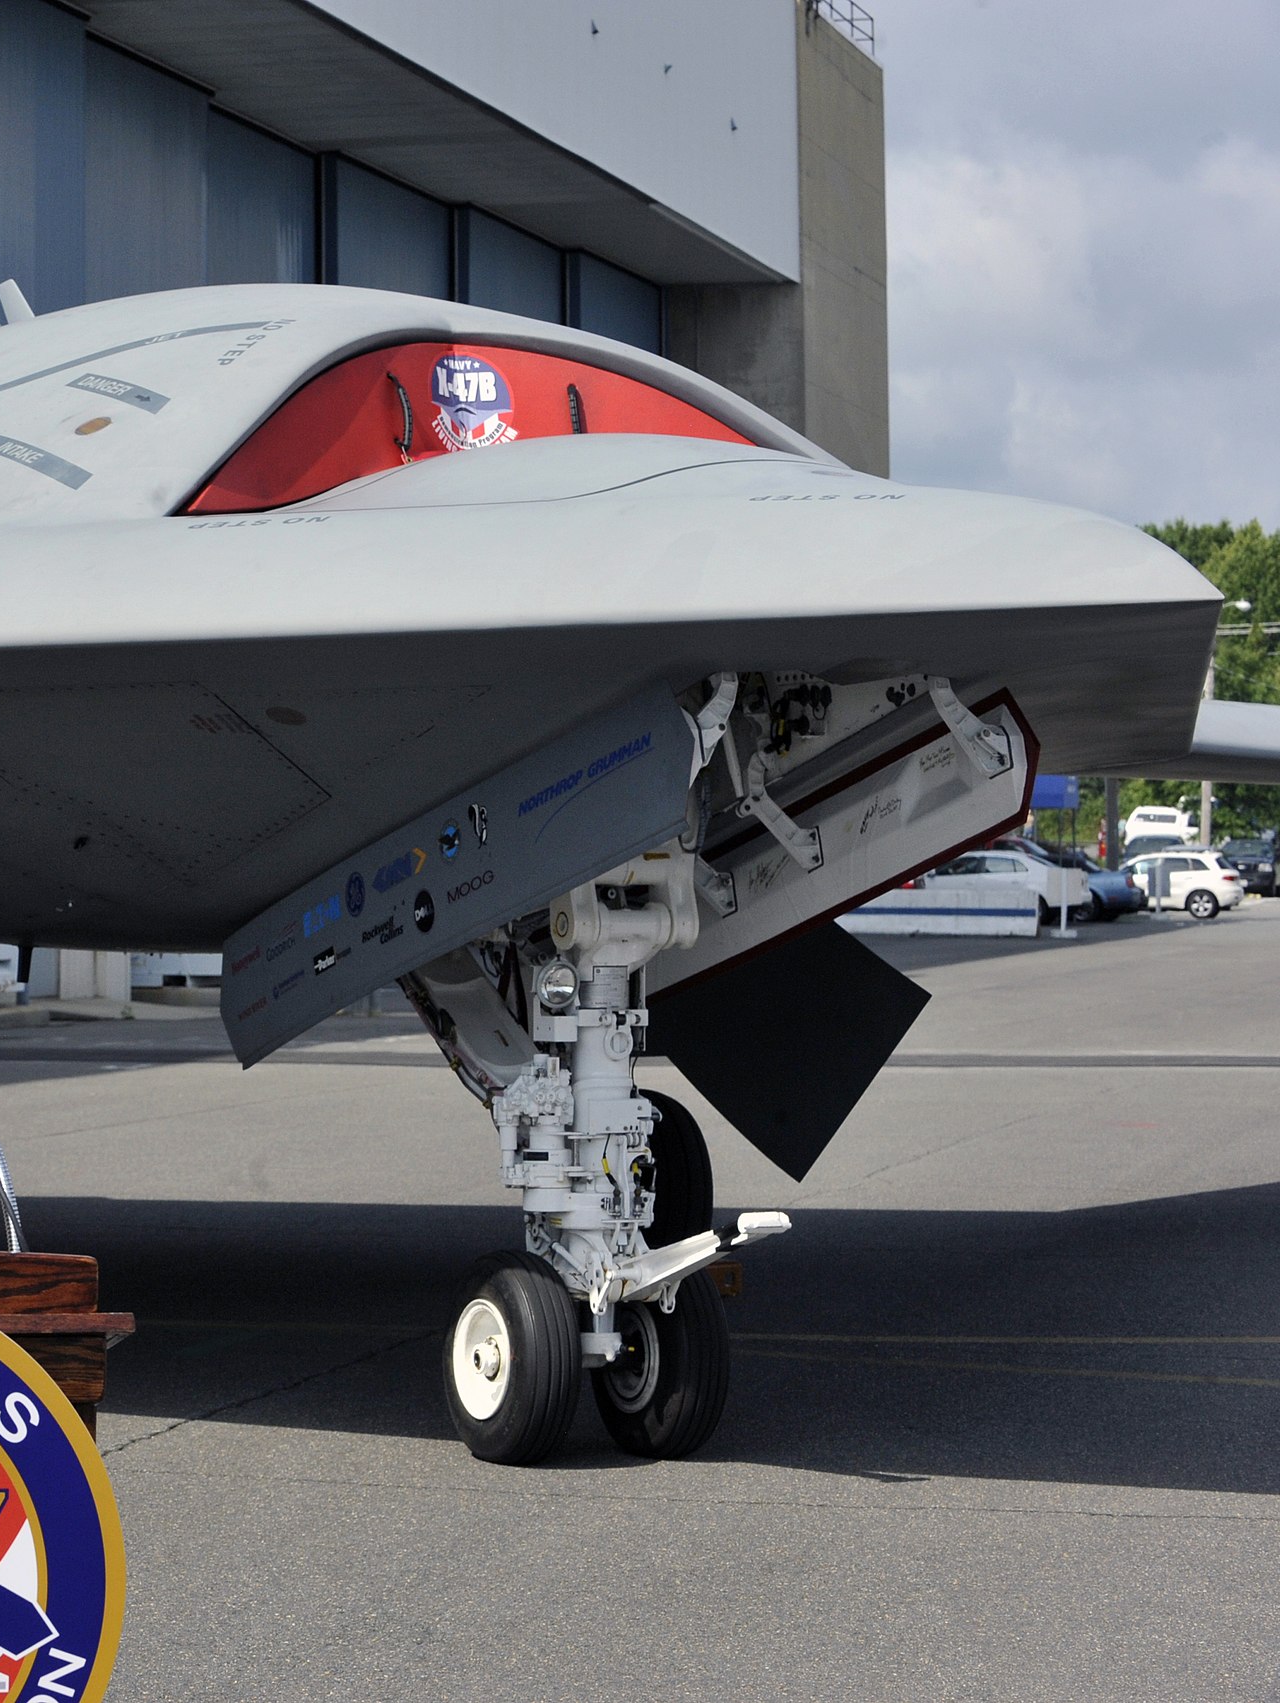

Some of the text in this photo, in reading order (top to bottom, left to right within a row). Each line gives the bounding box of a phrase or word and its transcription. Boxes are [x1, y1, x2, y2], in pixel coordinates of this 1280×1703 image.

[217, 318, 297, 366] NO STEP
[77, 376, 135, 396] DANGER
[435, 366, 497, 403] X-47B
[478, 422, 504, 446] Program
[748, 494, 841, 502] STEP
[188, 516, 331, 529] NO STEP
[518, 732, 651, 817] NORTHROP GRUMMAN
[447, 869, 494, 904] MOOG
[362, 916, 394, 943] Rockwell
[380, 925, 404, 944] Collins
